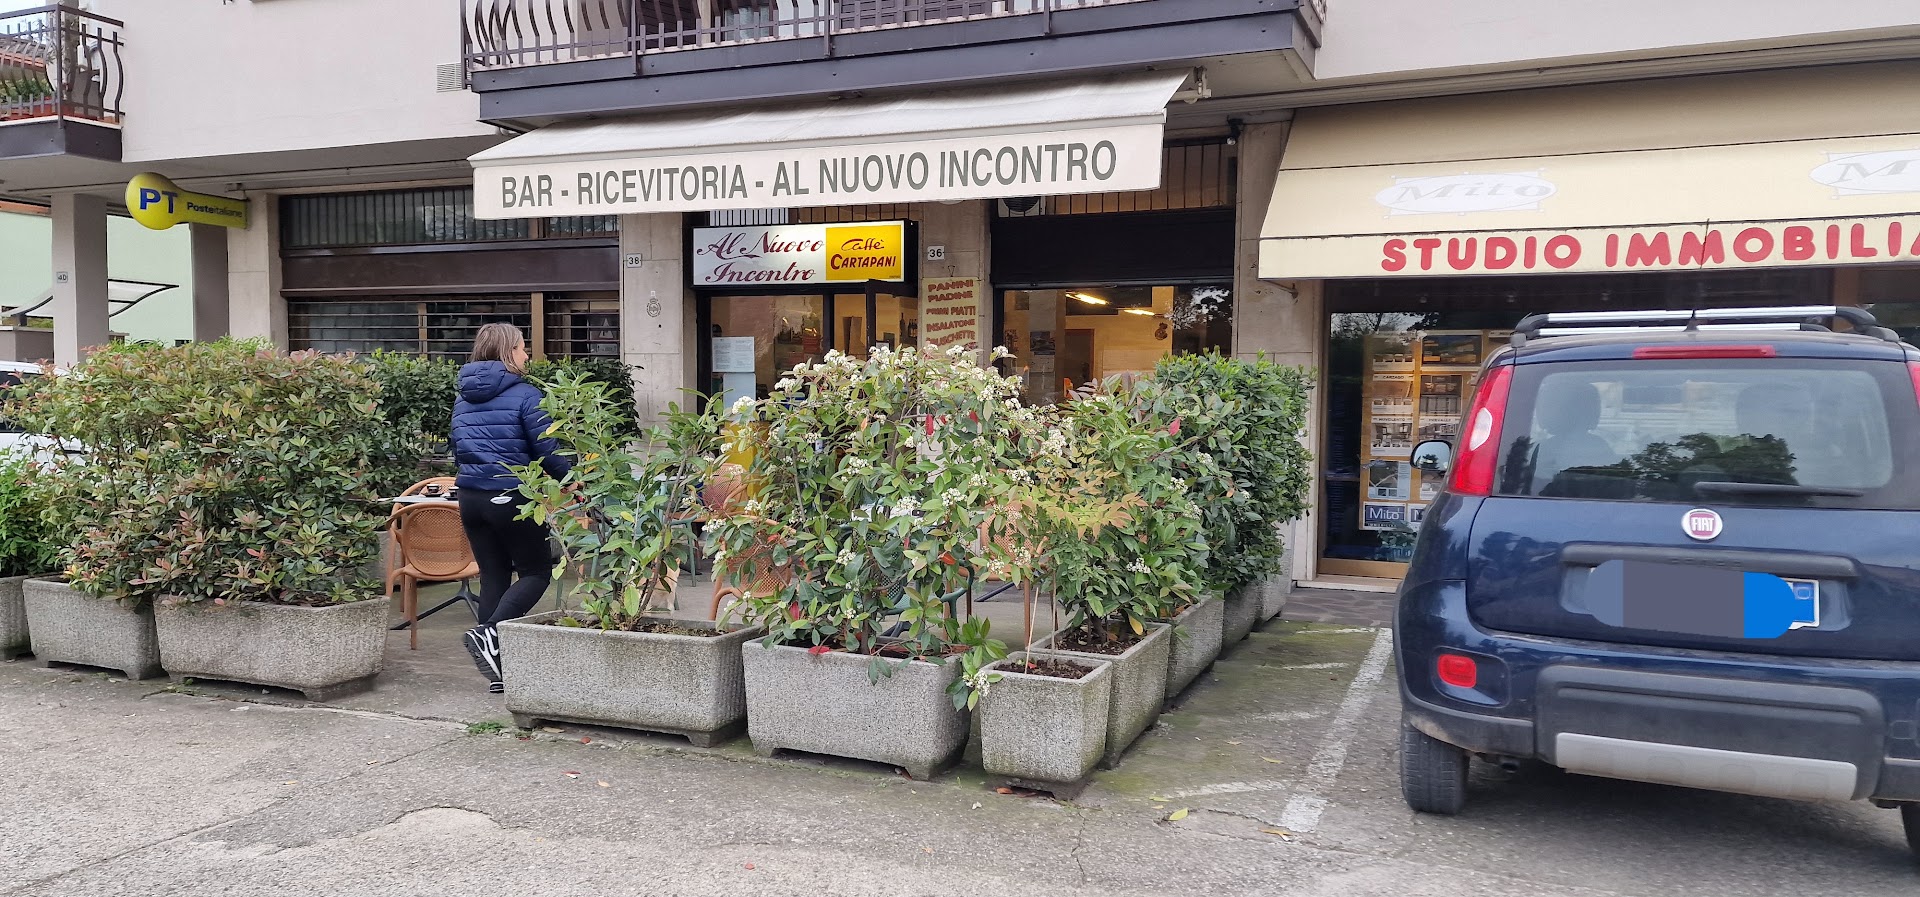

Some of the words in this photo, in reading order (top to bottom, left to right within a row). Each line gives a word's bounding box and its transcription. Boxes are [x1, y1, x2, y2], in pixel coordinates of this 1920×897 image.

[501, 174, 553, 208] BAR
[577, 164, 748, 206] RICEVITORIA
[772, 160, 810, 197] AL
[819, 152, 929, 194] NUOVO
[939, 139, 1117, 188] INCONTRO
[1390, 181, 1553, 205] Mito
[139, 187, 178, 214] PT
[186, 201, 243, 218] Posteitaliane
[696, 232, 762, 260] Al
[740, 230, 825, 255] Nuovo
[840, 238, 885, 252] Caffè
[1380, 234, 1582, 272] STUDIO
[1605, 221, 1920, 268] IMMOBILI
[929, 248, 942, 257] 36
[629, 257, 640, 265] 38
[830, 253, 897, 271] CARTAPANI
[704, 261, 817, 283] Incontro
[928, 279, 974, 292] PANINI
[928, 291, 973, 303] PIADINE
[950, 305, 976, 316] PIATTI
[926, 319, 975, 332] INSALATONE
[1369, 507, 1400, 520] Mito
[1691, 517, 1715, 531] FIAT
